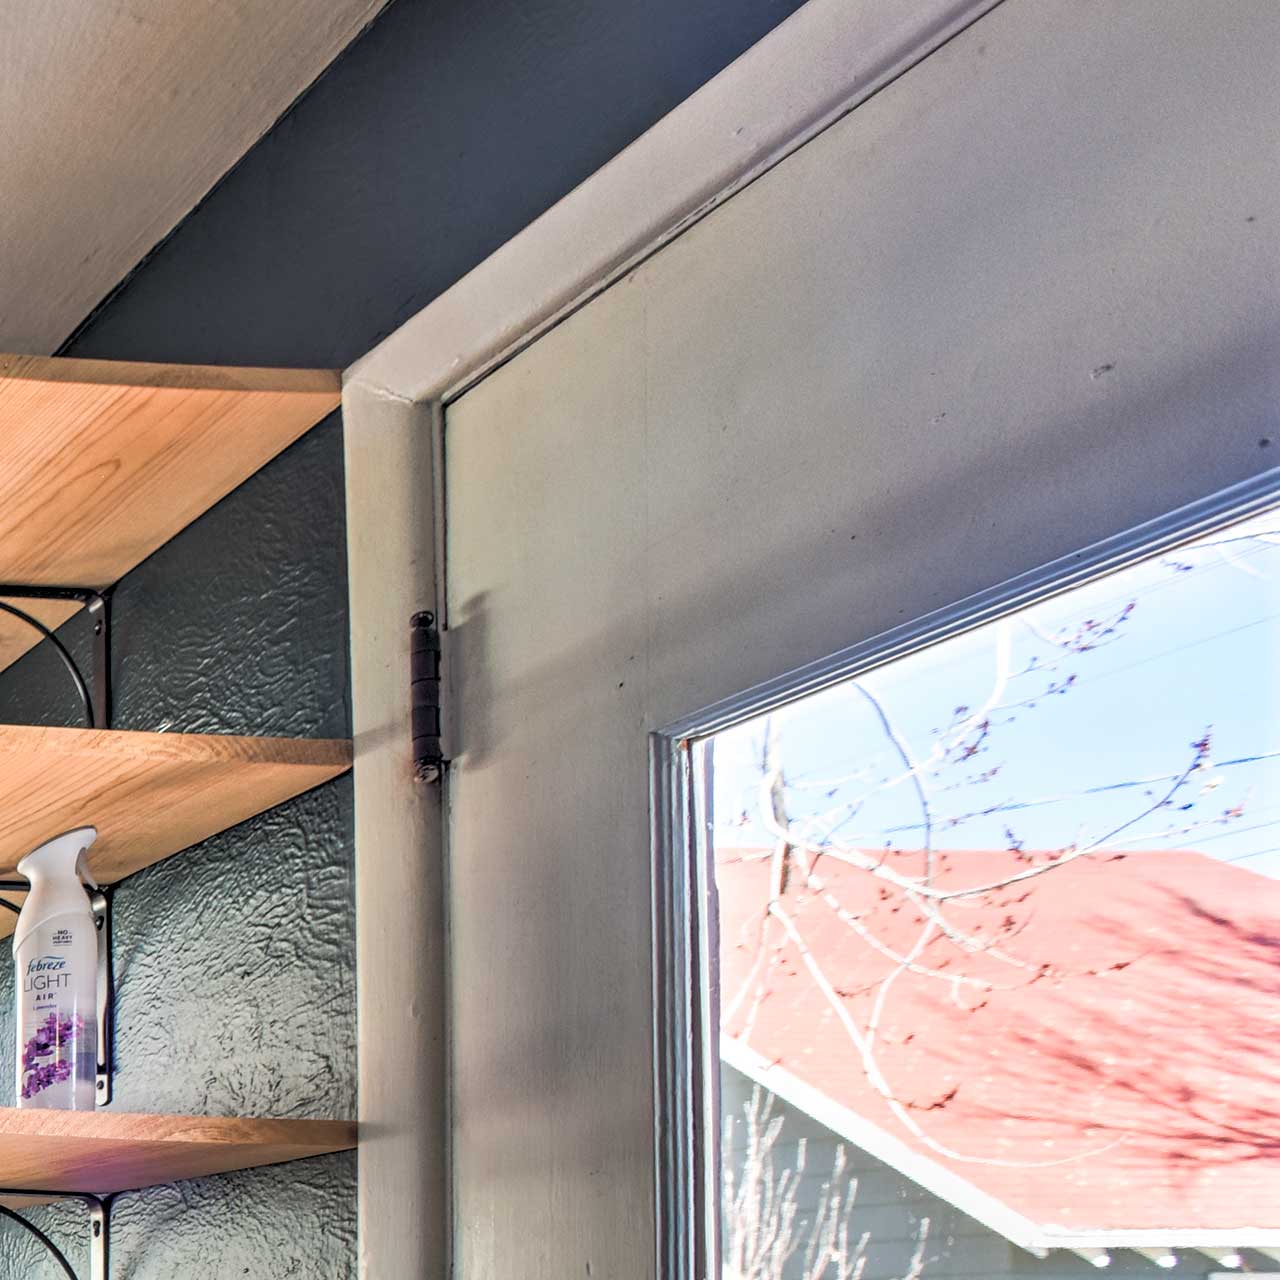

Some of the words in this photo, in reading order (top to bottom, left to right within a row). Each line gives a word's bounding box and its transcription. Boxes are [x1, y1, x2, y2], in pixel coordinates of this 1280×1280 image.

[26, 956, 66, 976] febreze
[24, 973, 72, 992] LIGHT
[35, 993, 54, 1001] AIR
